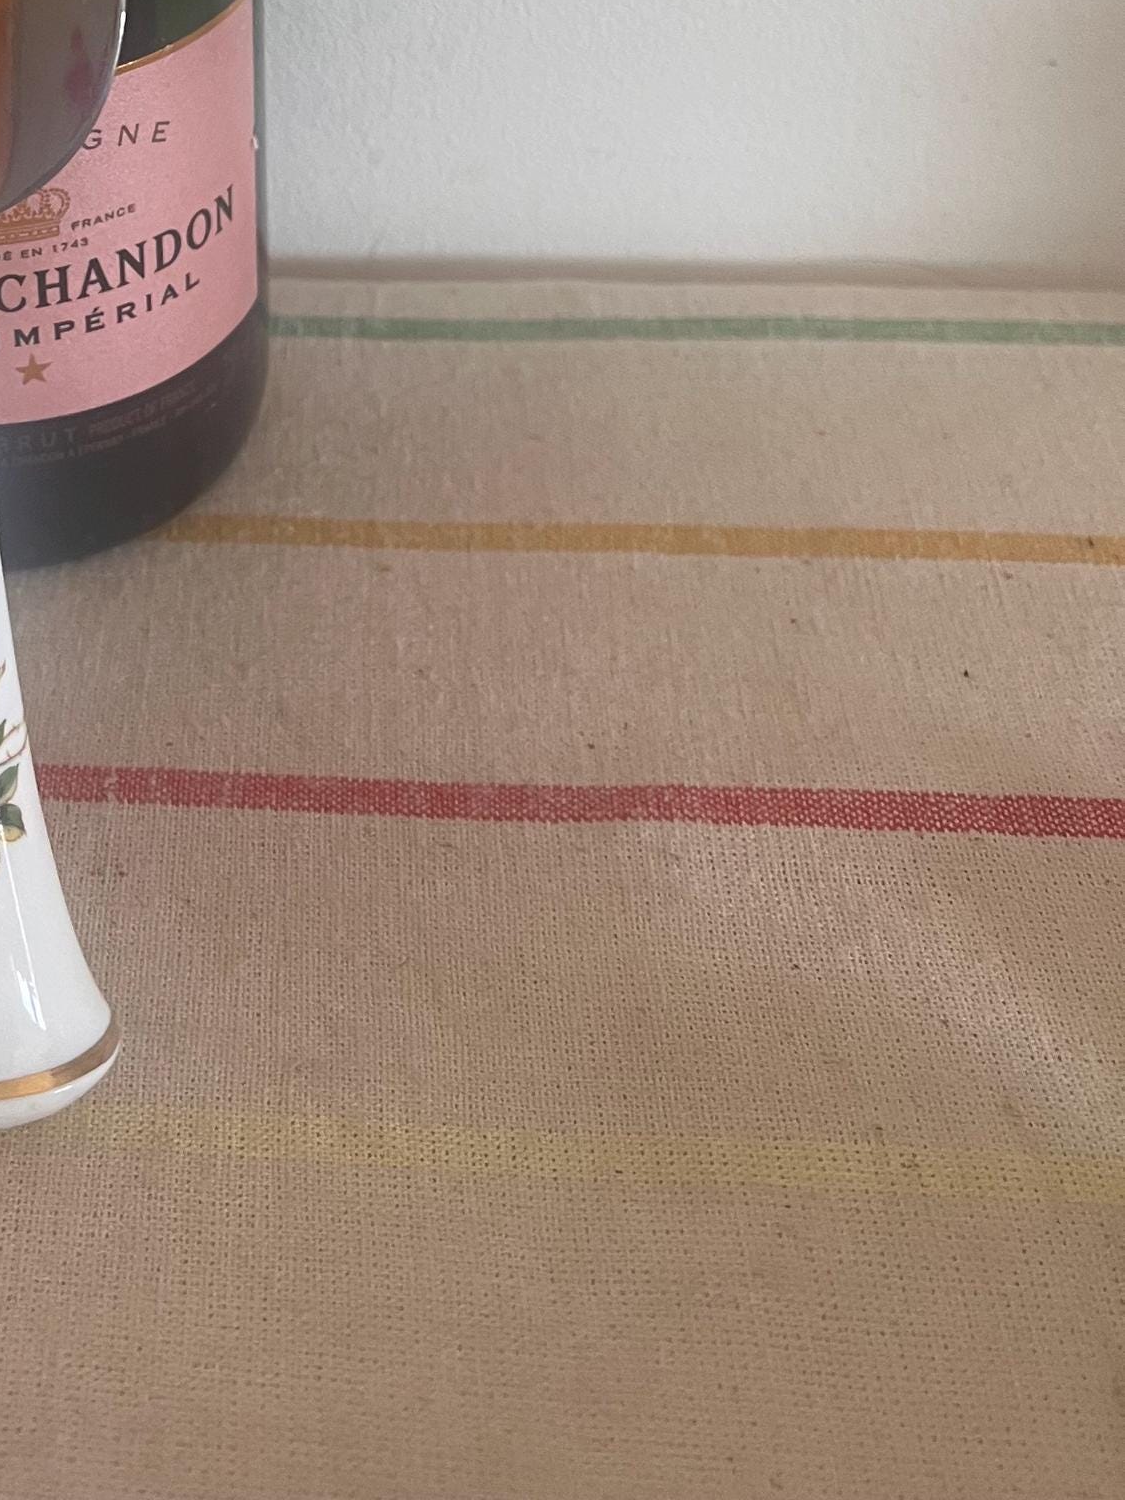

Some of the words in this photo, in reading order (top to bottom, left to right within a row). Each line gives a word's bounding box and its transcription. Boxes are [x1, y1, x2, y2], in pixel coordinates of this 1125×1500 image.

[70, 203, 137, 232] FRANCE
[20, 247, 43, 259] EN
[51, 237, 89, 253] 1743
